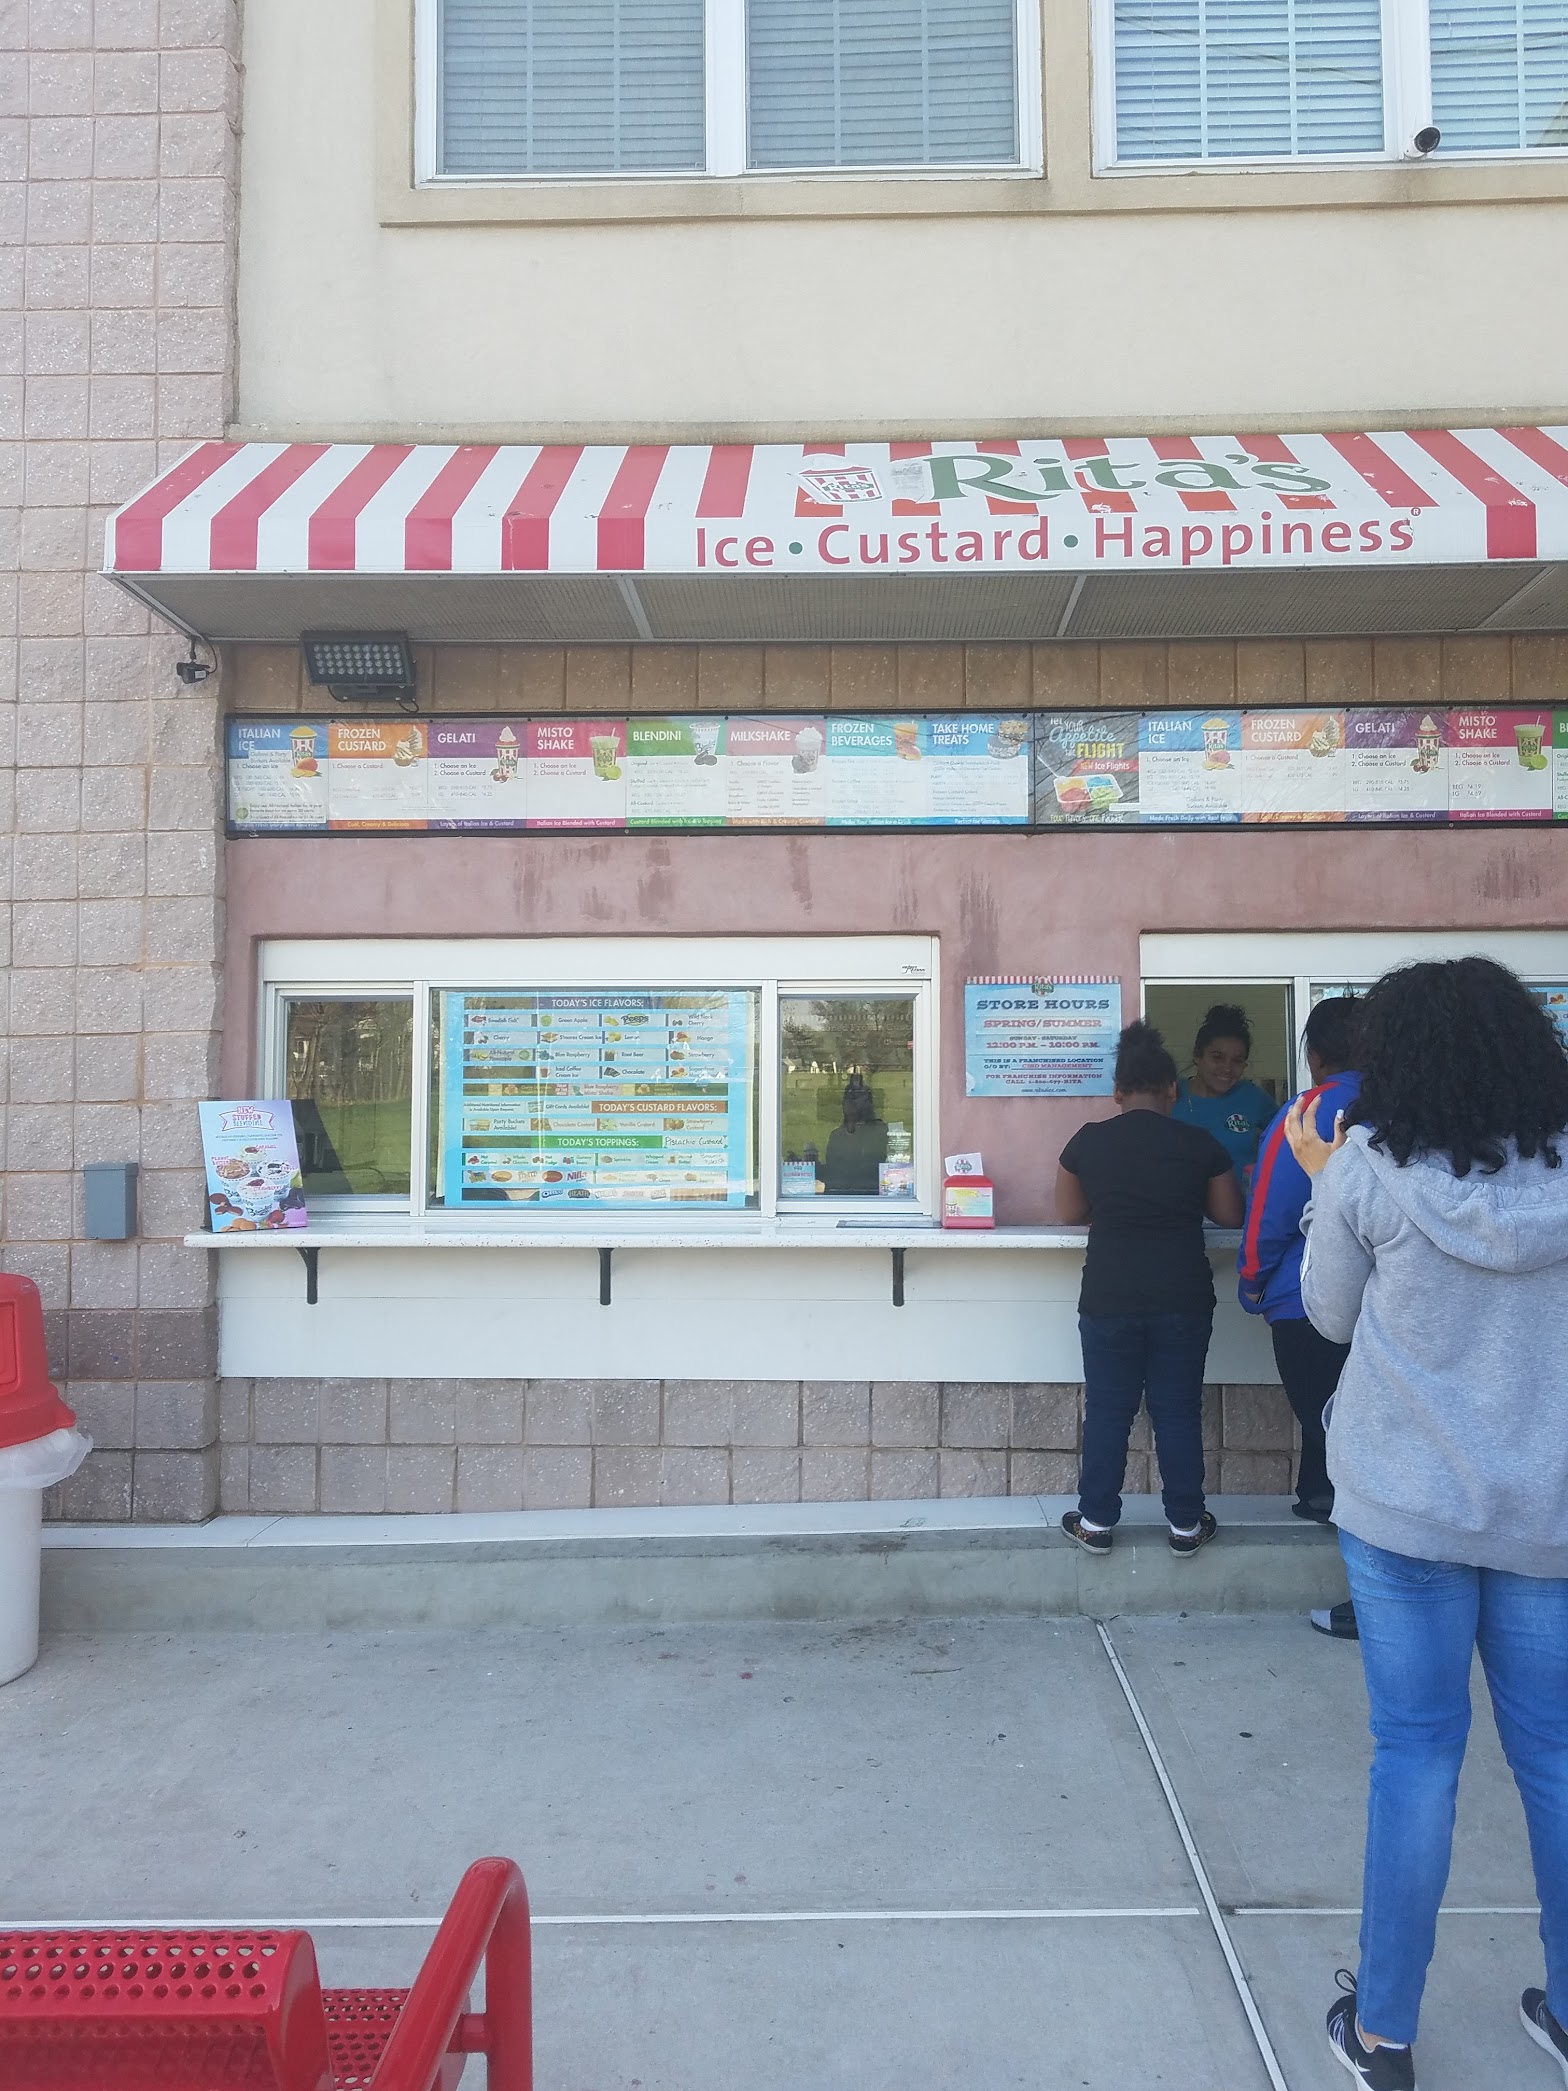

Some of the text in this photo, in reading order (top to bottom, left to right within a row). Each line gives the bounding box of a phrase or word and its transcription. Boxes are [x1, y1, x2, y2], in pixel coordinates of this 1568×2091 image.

[923, 454, 1337, 503] Rita's
[697, 512, 1414, 567] Ice Custard Happiness
[1148, 721, 1191, 731] ITALIAN
[1251, 720, 1295, 730] FROZEN
[1459, 716, 1495, 726] MISTO
[537, 727, 573, 737] MISTO
[832, 724, 874, 733] FROZEN
[933, 724, 994, 733] TAKE HOME
[1356, 723, 1395, 733] GELATI
[238, 729, 280, 738] ITALIAN
[338, 729, 380, 738] FROZEN
[438, 733, 476, 743] GELATI
[633, 731, 681, 740] BLENDINI
[731, 731, 790, 741] MILKSHAKE
[1049, 725, 1116, 749] Appetite
[1251, 732, 1302, 742] CUSTARD
[1459, 729, 1497, 739] SHAKE
[832, 736, 892, 745] BEVERAGES
[933, 735, 969, 744] TREATS
[1148, 734, 1165, 744] ICE
[238, 741, 255, 750] ICE
[338, 741, 386, 751] CUSTARD
[537, 740, 574, 749] SHAKE
[1076, 743, 1125, 758] FLIGHT
[1081, 762, 1093, 770] NEW
[1106, 762, 1130, 771] Flights
[552, 999, 587, 1007] TODAY'S
[604, 999, 644, 1007] FLAVORS:
[977, 1000, 1109, 1010] STORE HOURS
[595, 1138, 639, 1146] TOPPINGS:
[665, 1137, 723, 1146] Pistachio Custard
